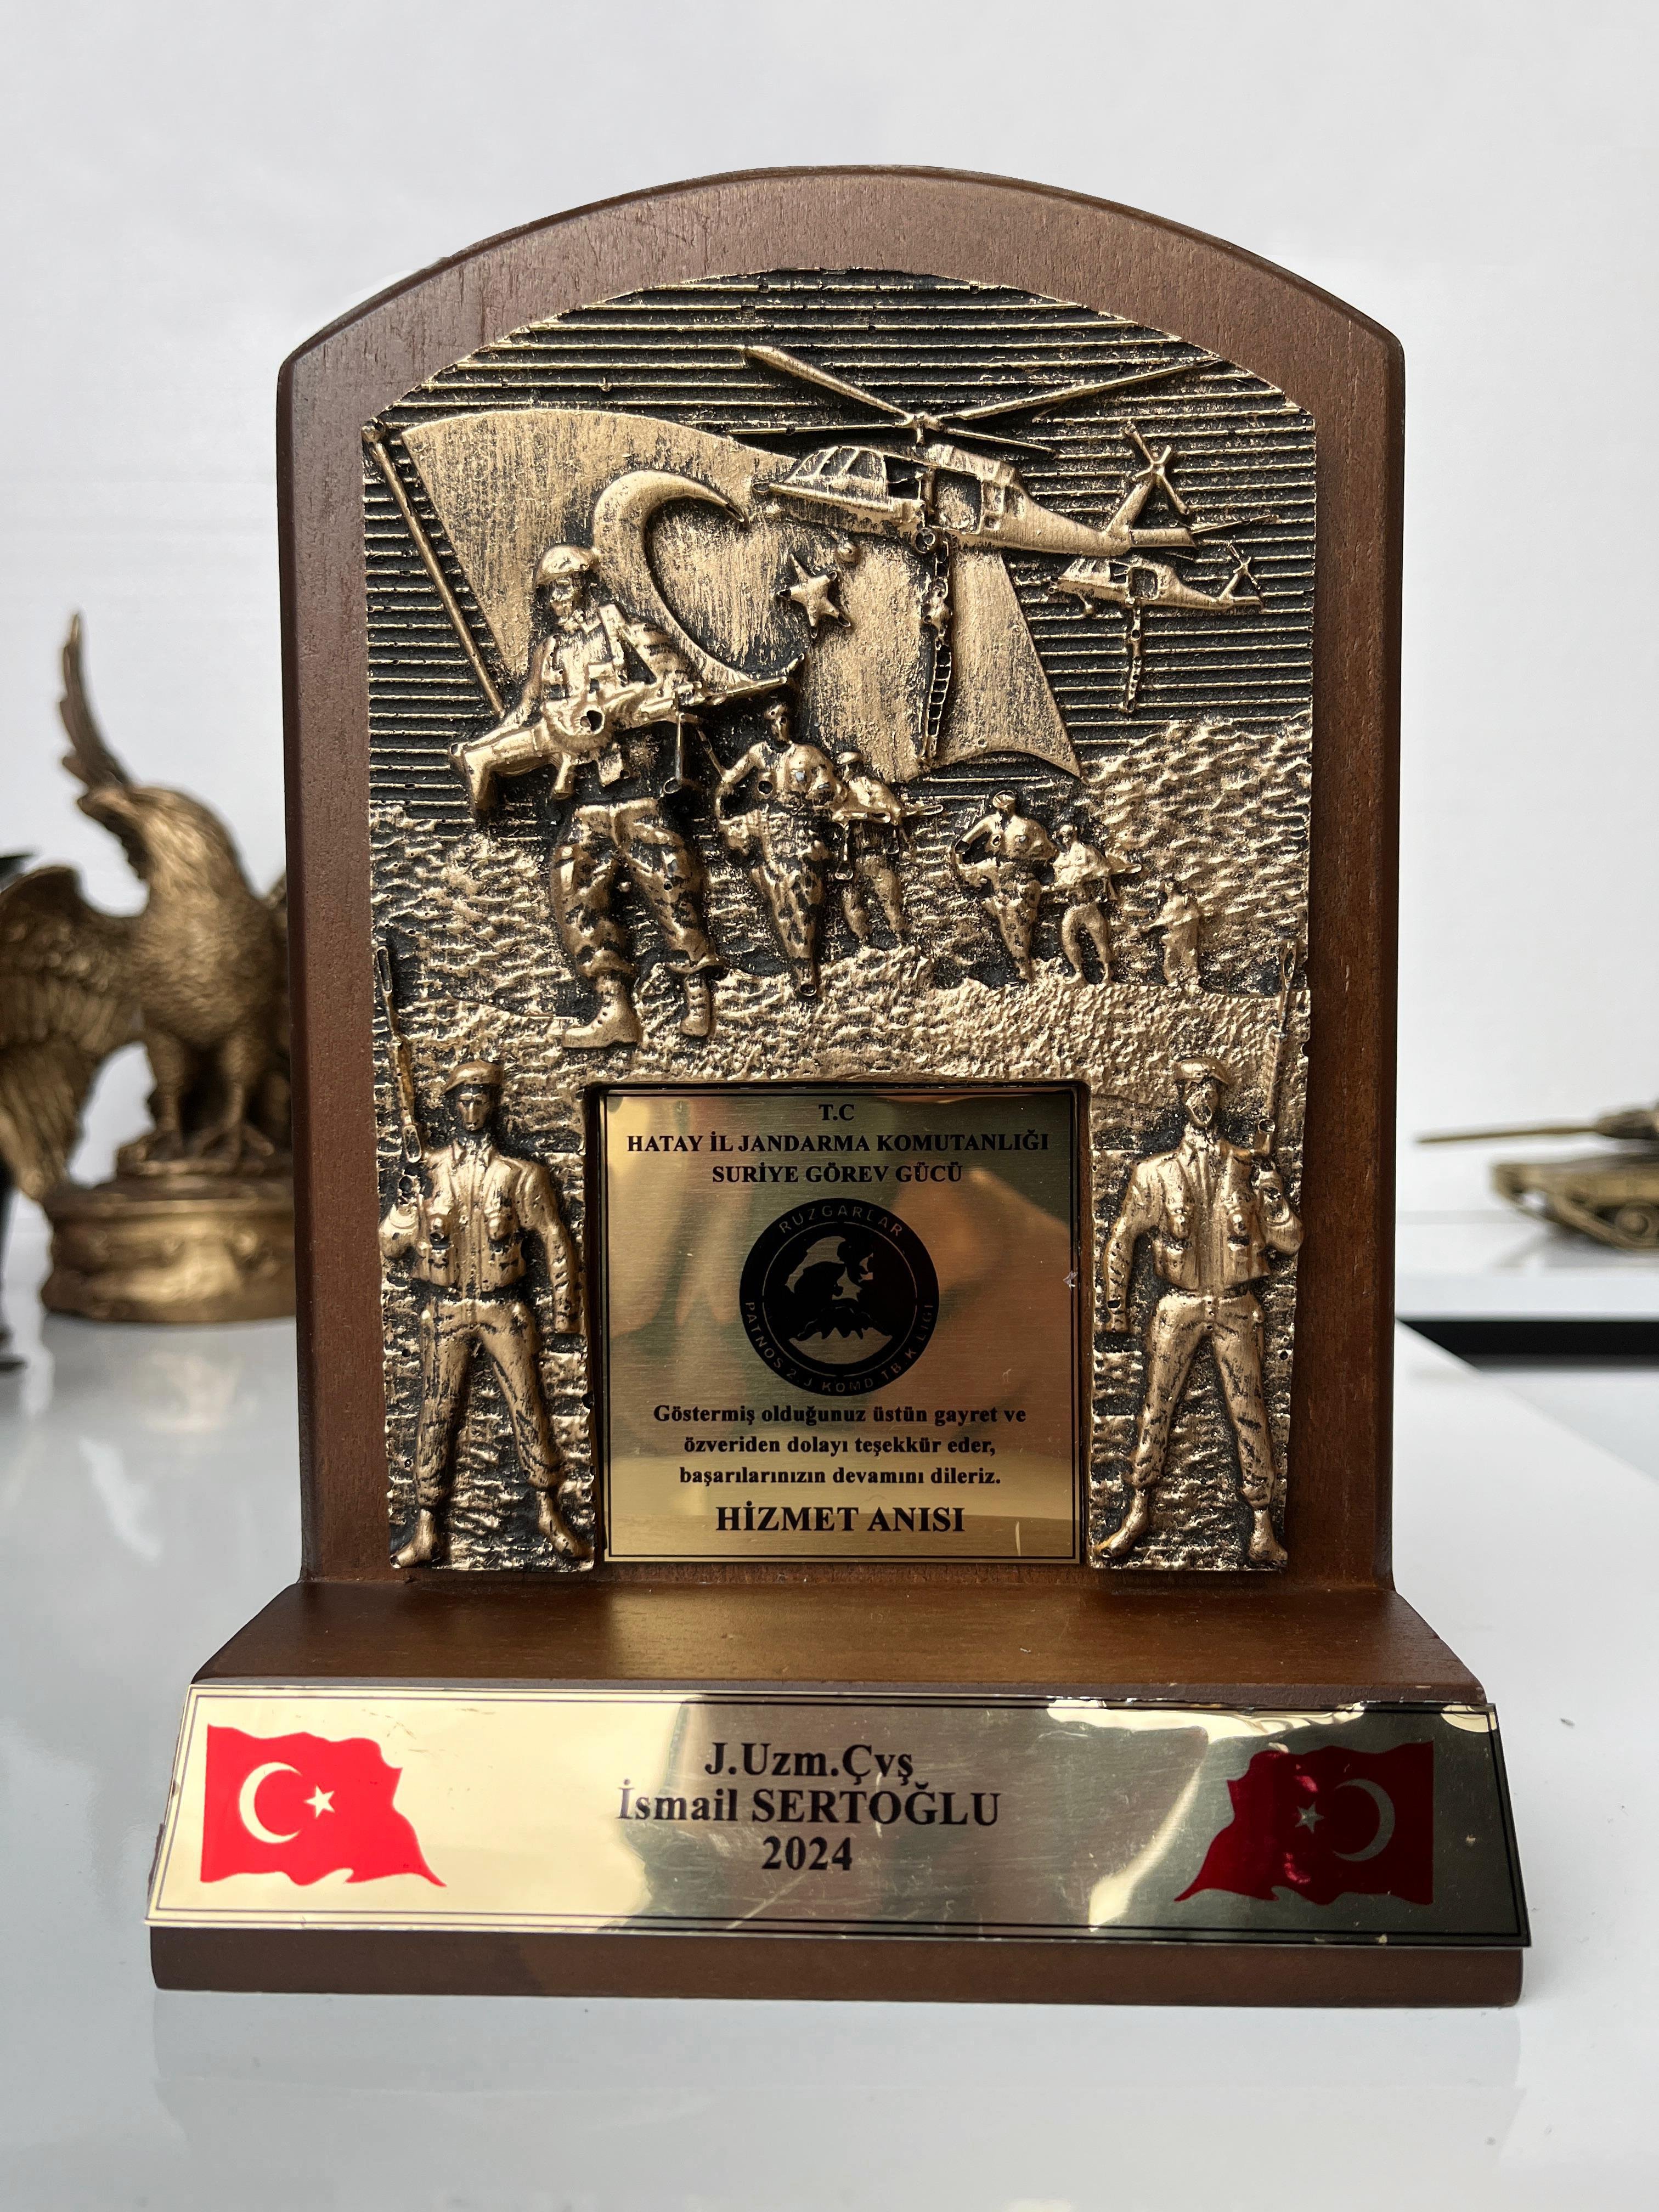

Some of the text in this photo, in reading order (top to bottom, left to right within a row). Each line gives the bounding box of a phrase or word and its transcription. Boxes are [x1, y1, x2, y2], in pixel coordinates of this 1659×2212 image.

[819, 1104, 854, 1121] T.C
[628, 1129, 1048, 1152] HATAY İL JANDARMA KOMUTANLIĞI
[713, 1161, 963, 1182] SURİYE GÖREV GÜCÜ
[745, 1302, 783, 1368] PATNOS
[654, 1405, 1025, 1427] Göstermiş olduğunuz üstün gayret ve
[685, 1436, 995, 1457] özveriden dolayı teşekkür eder,
[680, 1467, 1000, 1486] başarılarınızın devamını dileriz.
[716, 1501, 964, 1532] HİZMET ANISI
[705, 1743, 913, 1786] J.Uzm.Çvş
[617, 1779, 1000, 1825] İsmail SERTOĞLU
[761, 1836, 852, 1871] 2024
